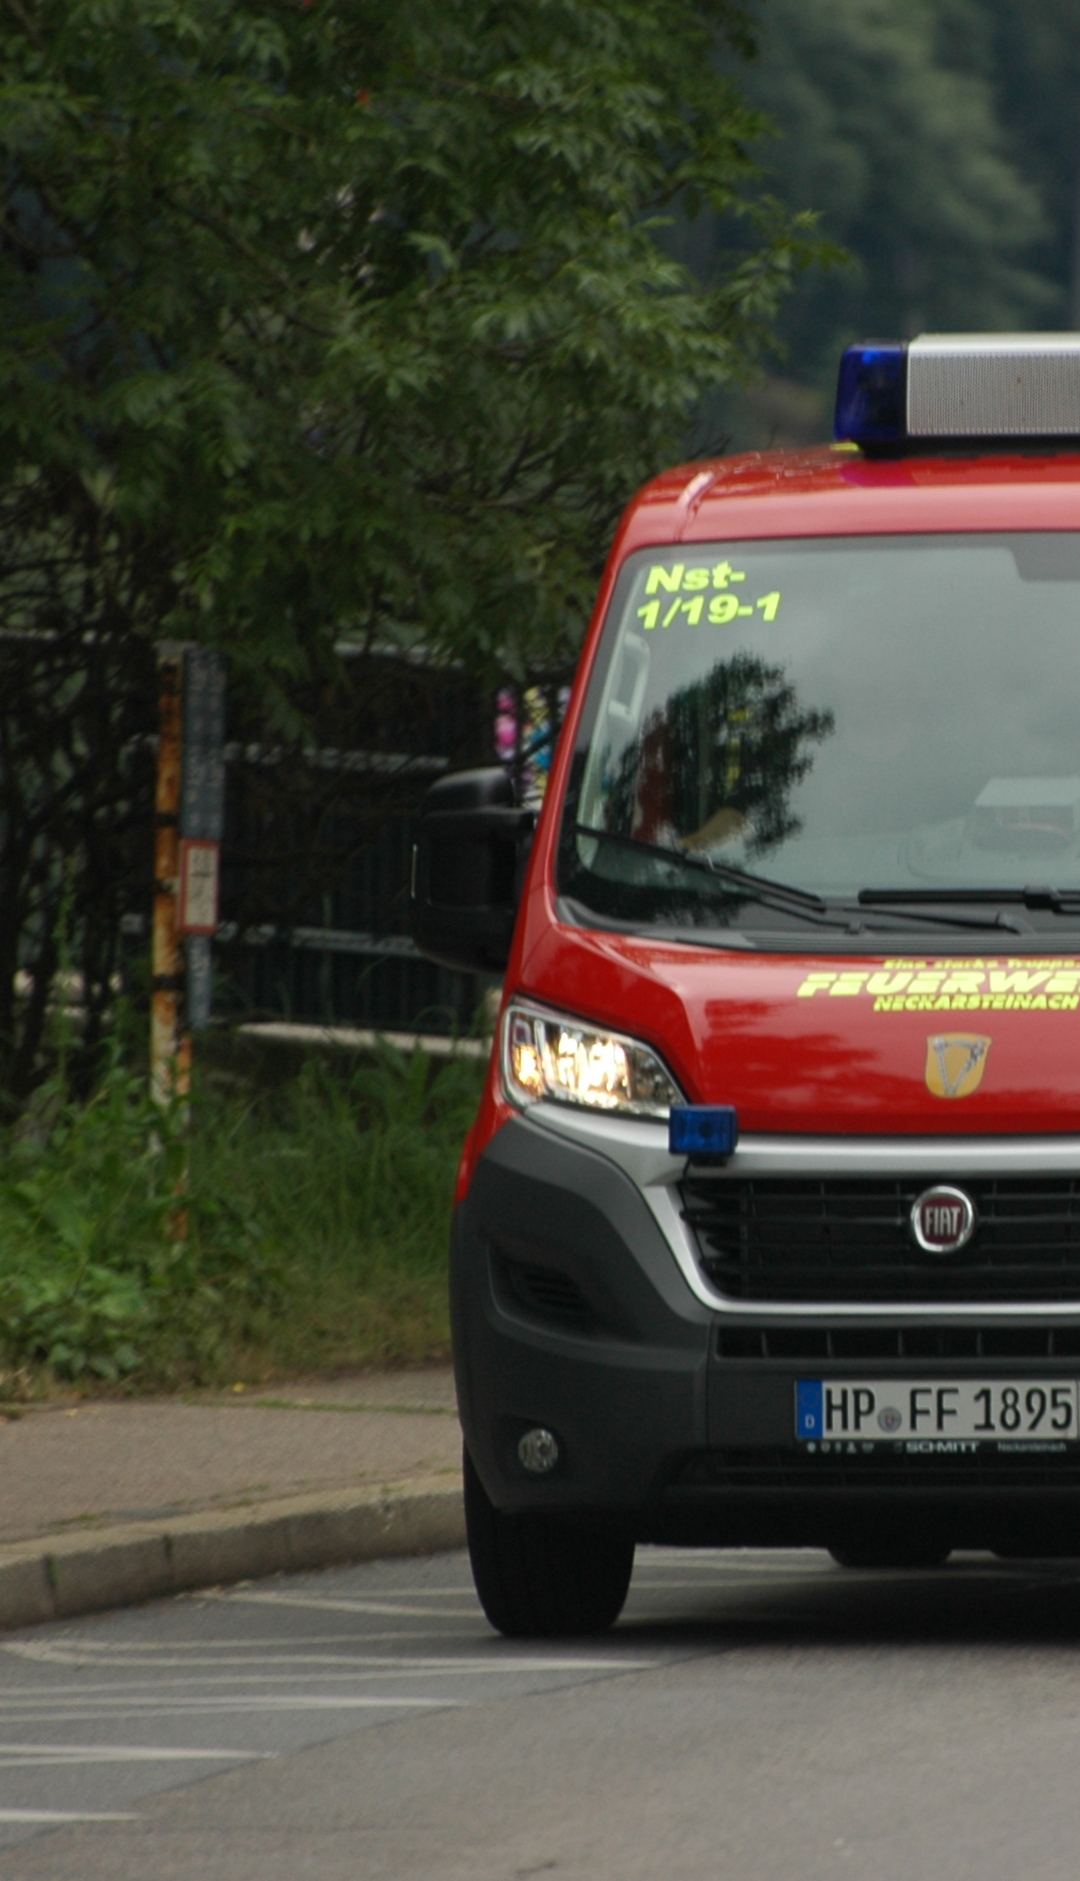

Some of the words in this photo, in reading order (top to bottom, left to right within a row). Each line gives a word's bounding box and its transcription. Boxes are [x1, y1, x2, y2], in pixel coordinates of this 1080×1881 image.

[645, 561, 745, 594] Nst-
[637, 591, 780, 629] 1/19-1
[873, 995, 1080, 1011] NECKARSTEINACH
[925, 1206, 961, 1237] FIAT
[805, 1414, 815, 1429] D
[825, 1388, 876, 1432] HP
[909, 1388, 960, 1432] FF
[973, 1388, 1073, 1432] 1895
